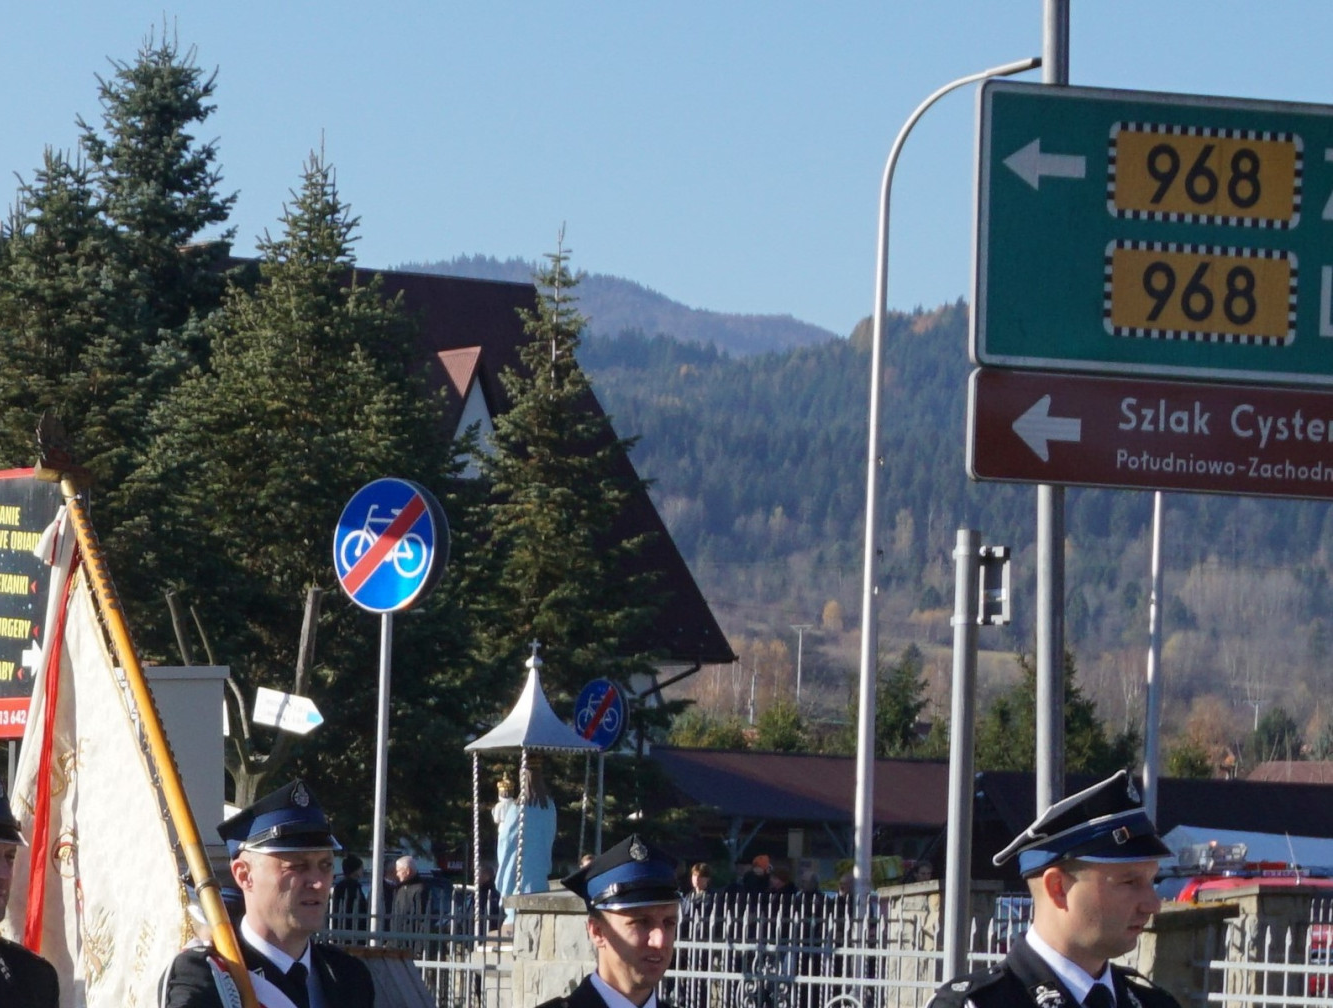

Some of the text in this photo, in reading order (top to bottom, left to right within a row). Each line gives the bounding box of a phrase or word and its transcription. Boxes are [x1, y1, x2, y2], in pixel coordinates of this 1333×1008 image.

[1147, 144, 1261, 208] 968
[1142, 262, 1256, 326] 968
[1119, 397, 1333, 448] Szlak Cyste
[9, 710, 26, 725] 642
